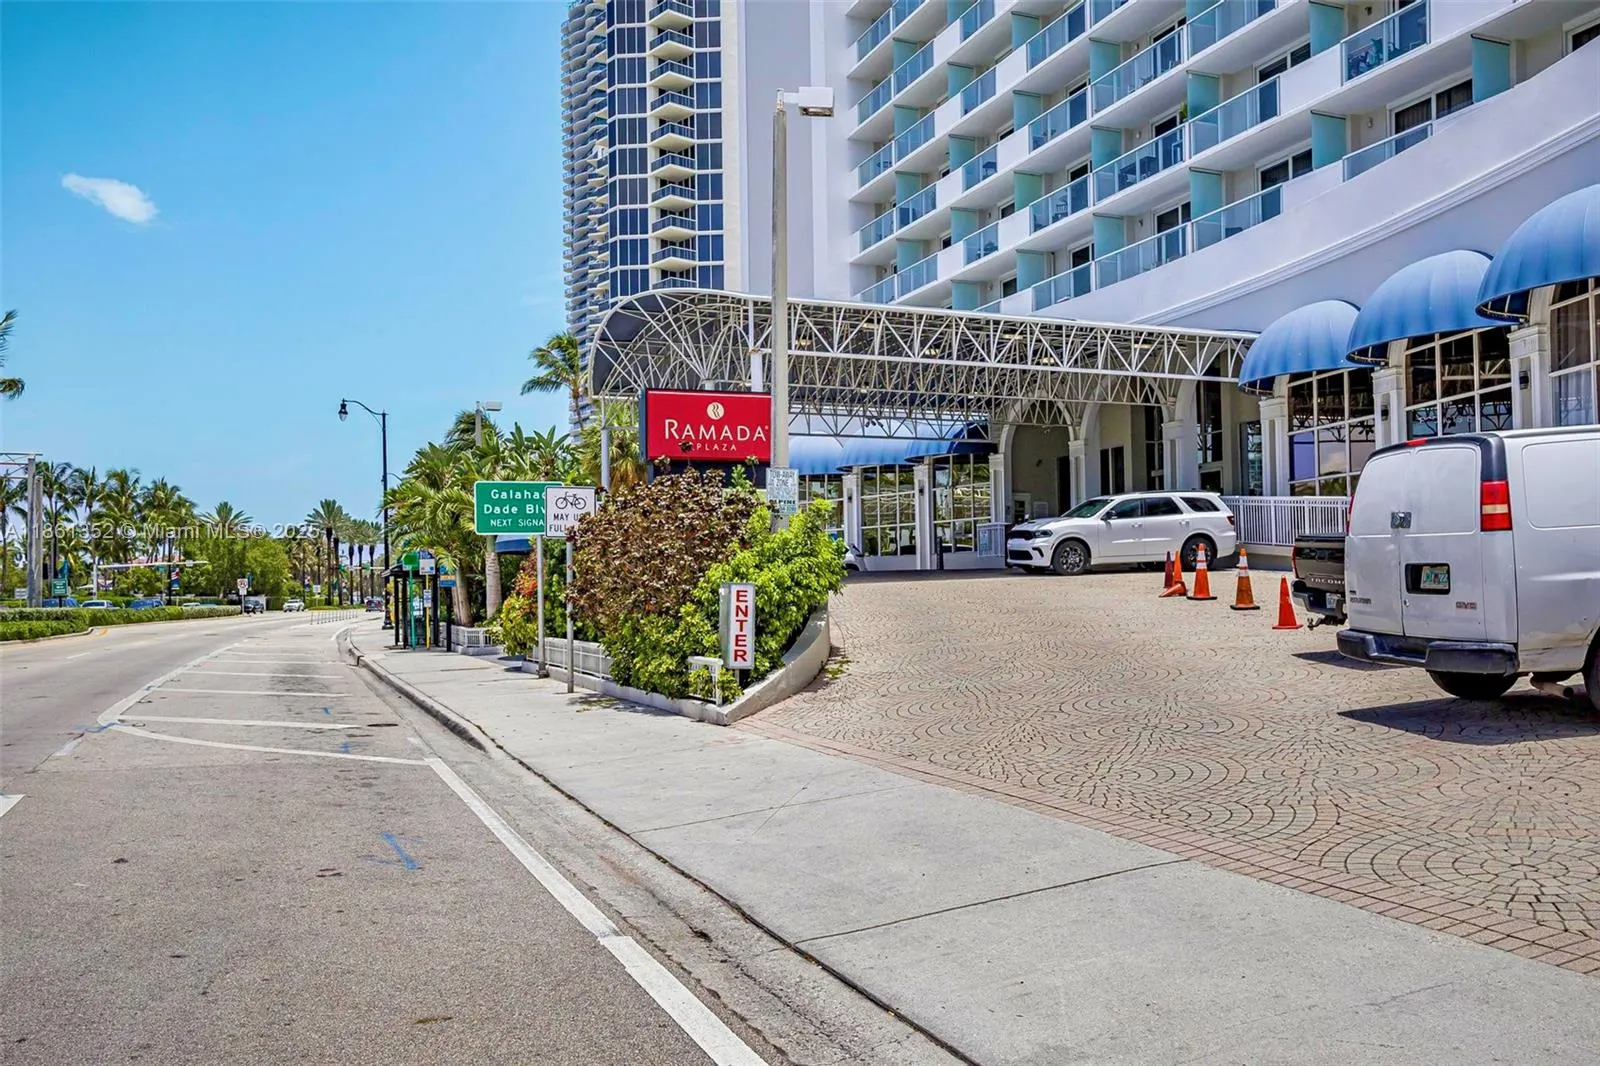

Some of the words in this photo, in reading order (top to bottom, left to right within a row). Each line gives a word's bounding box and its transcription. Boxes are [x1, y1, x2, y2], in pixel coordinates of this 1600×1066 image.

[665, 419, 766, 442] RAMADA
[696, 443, 737, 452] PLAZA
[483, 504, 518, 514] Dade
[526, 504, 545, 514] Blv
[553, 513, 569, 521] MAY
[490, 518, 512, 527] NEXT
[518, 518, 545, 527] SIGNA
[734, 590, 749, 662] ENTER
